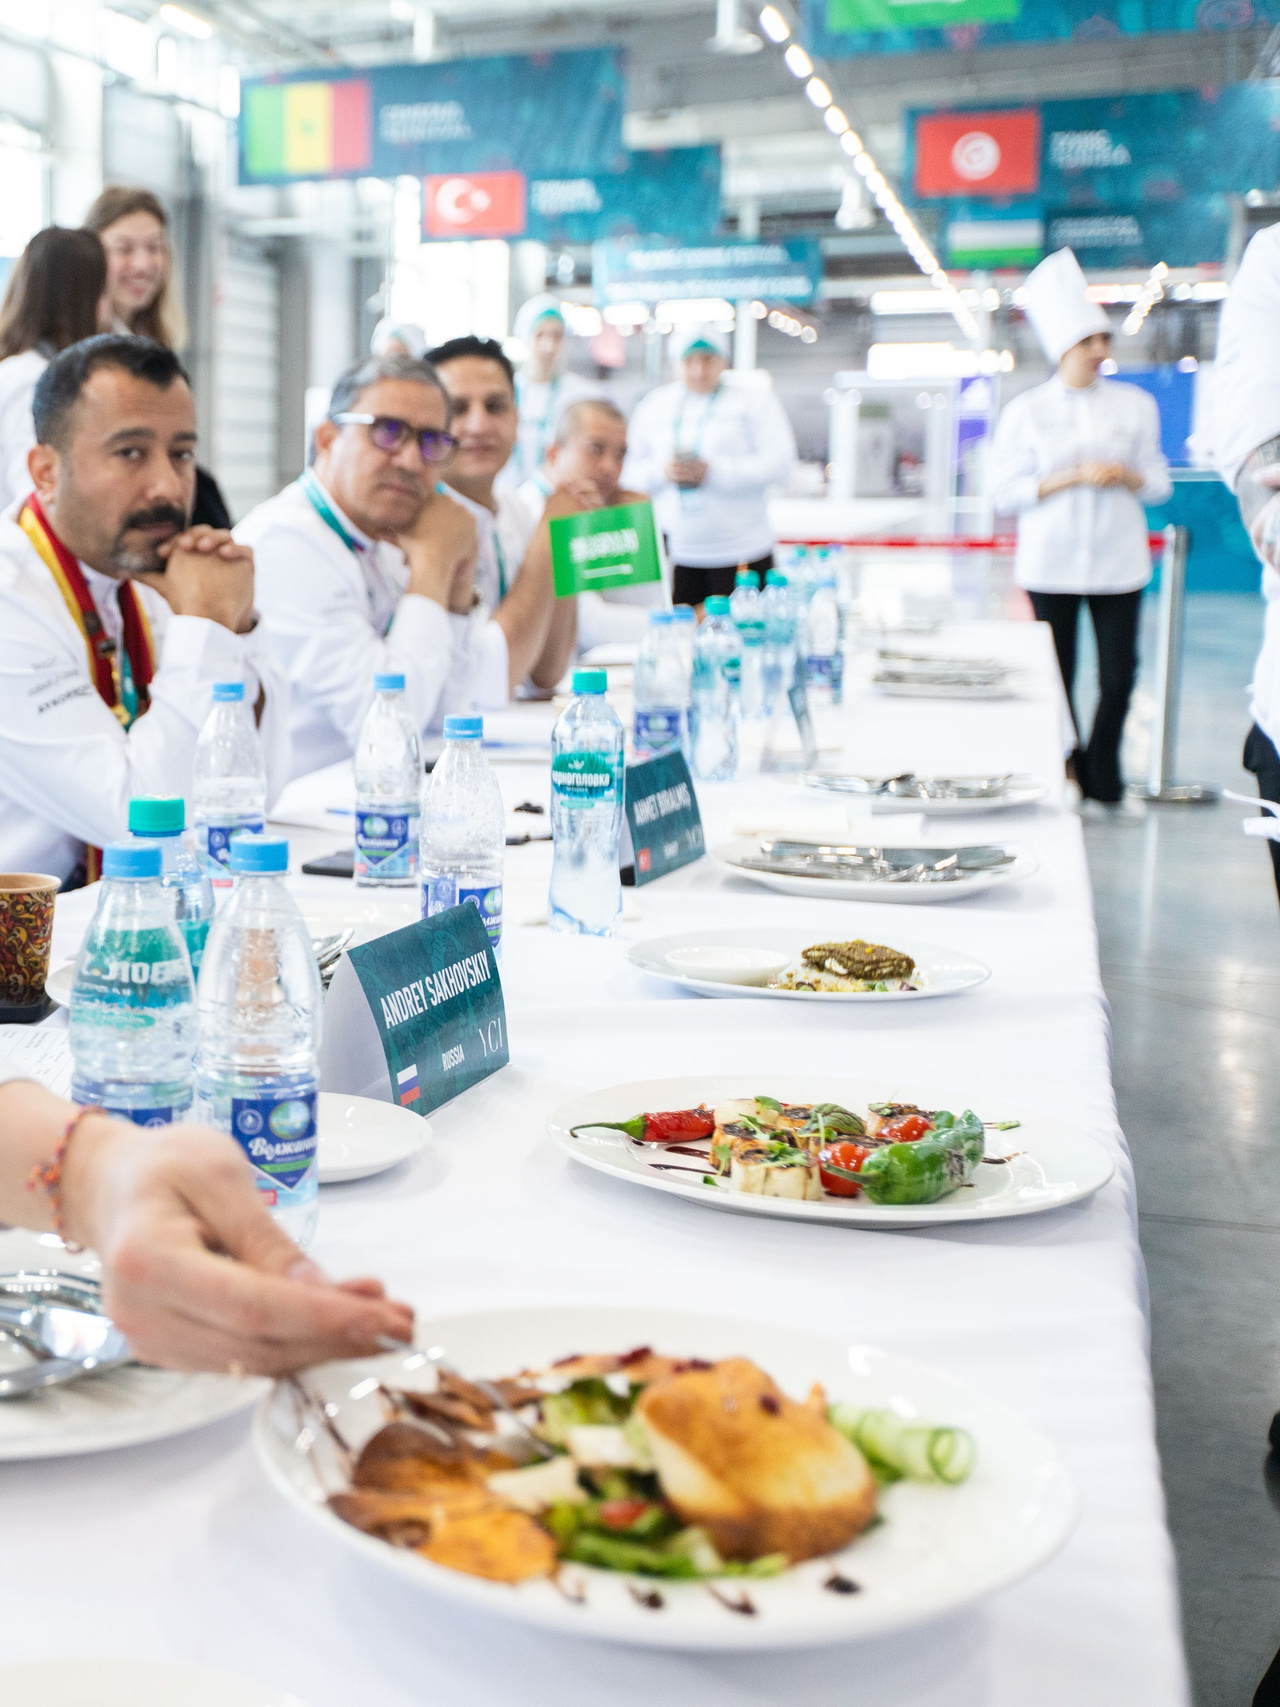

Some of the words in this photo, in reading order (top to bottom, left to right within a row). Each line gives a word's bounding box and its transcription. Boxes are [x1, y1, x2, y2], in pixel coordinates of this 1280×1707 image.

[380, 979, 429, 1029] ANDREY
[424, 950, 491, 1007] SAKHOVSKIY
[442, 1044, 465, 1071] RUSSIA
[478, 1017, 503, 1058] YCI
